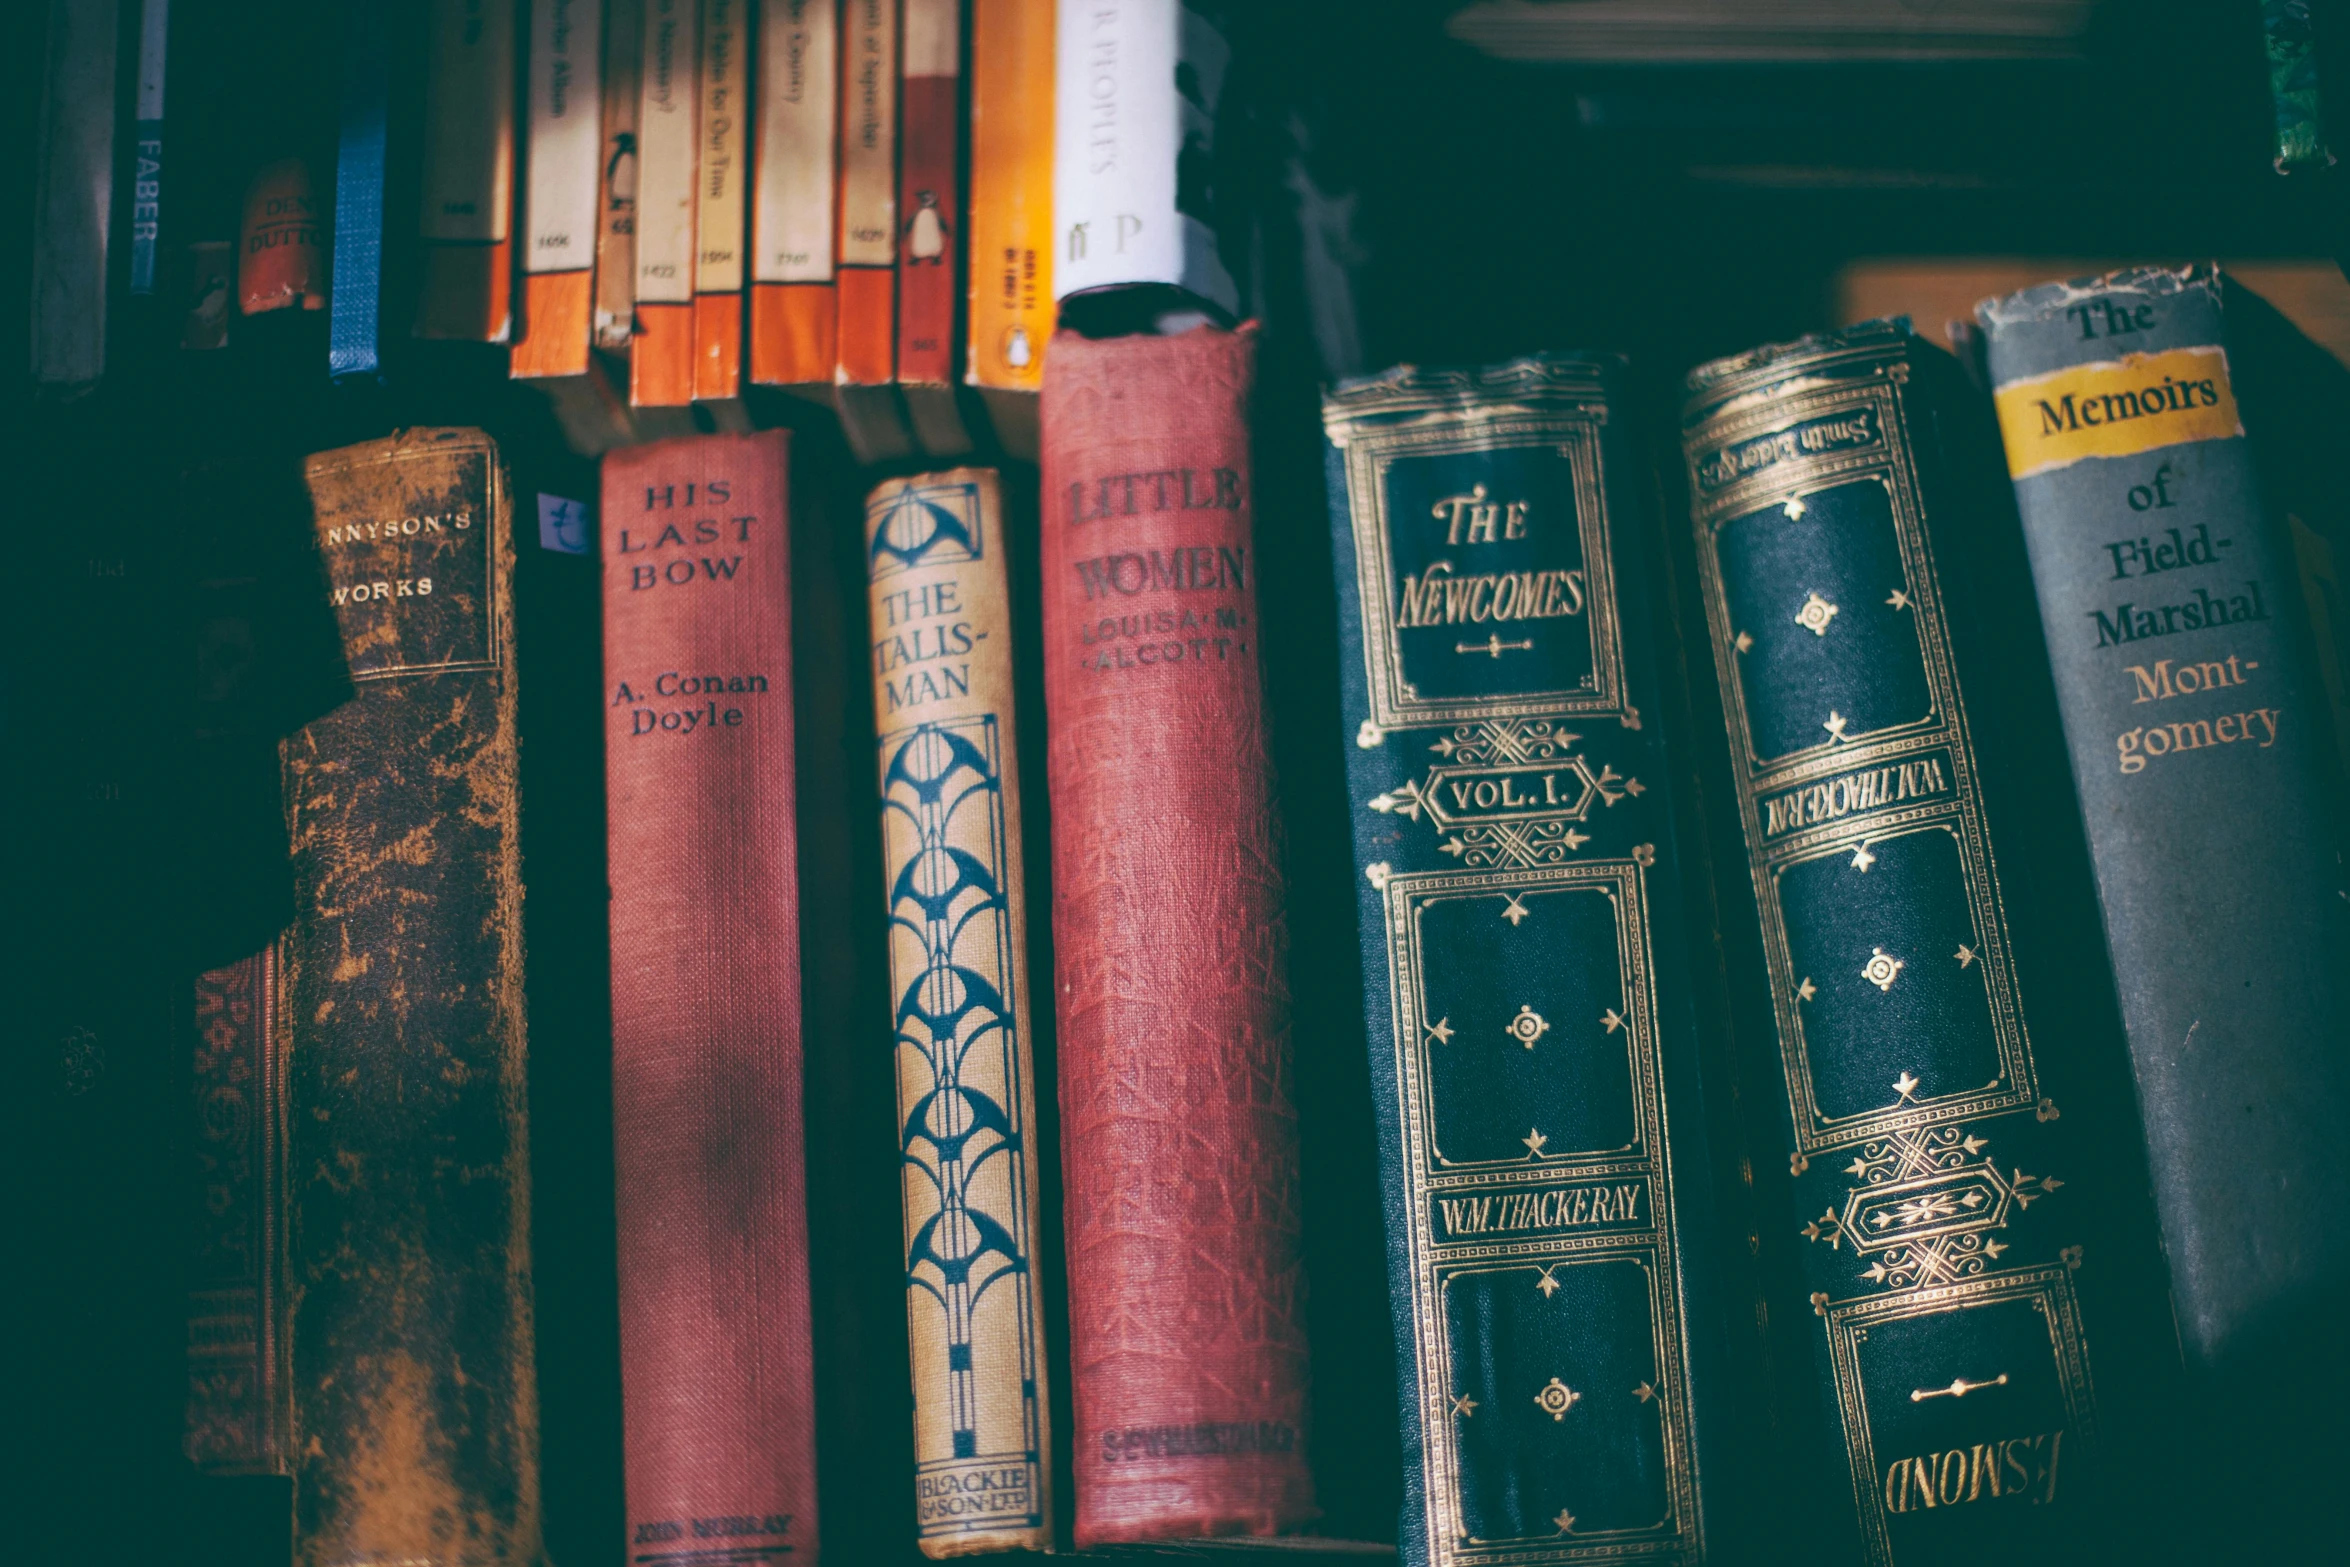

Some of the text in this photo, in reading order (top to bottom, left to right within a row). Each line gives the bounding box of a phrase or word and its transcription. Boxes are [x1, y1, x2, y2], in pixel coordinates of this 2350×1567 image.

[711, 117, 732, 151] Our
[133, 140, 161, 241] FABER
[709, 156, 731, 199] Time
[2066, 297, 2157, 342] The
[2031, 374, 2219, 439] Memoirs
[1799, 414, 1871, 452] Smith
[646, 480, 732, 511] HIS
[1069, 466, 1243, 526] LITTLE
[2127, 462, 2176, 513] of
[326, 511, 471, 546] NNYSON'S
[619, 516, 757, 554] LAST
[1431, 481, 1531, 546] THE
[632, 556, 744, 591] BOW
[1075, 546, 1246, 601] WOMEN
[2104, 522, 2234, 582] Field-
[330, 577, 433, 607] WORKS
[881, 581, 963, 628] THE
[1396, 559, 1585, 629] NEWCOMES
[2086, 579, 2272, 650] Marshal
[874, 621, 989, 675] TALIS-
[611, 671, 769, 707] A. Conan
[884, 663, 971, 714] MAN
[2122, 653, 2260, 705] Mont-
[632, 701, 744, 736] Doyle
[2115, 707, 2282, 775] gomery
[1449, 775, 1538, 810] VOL.
[921, 1468, 1027, 1498] BLACKIE
[1885, 1429, 2065, 1515] ESMOND
